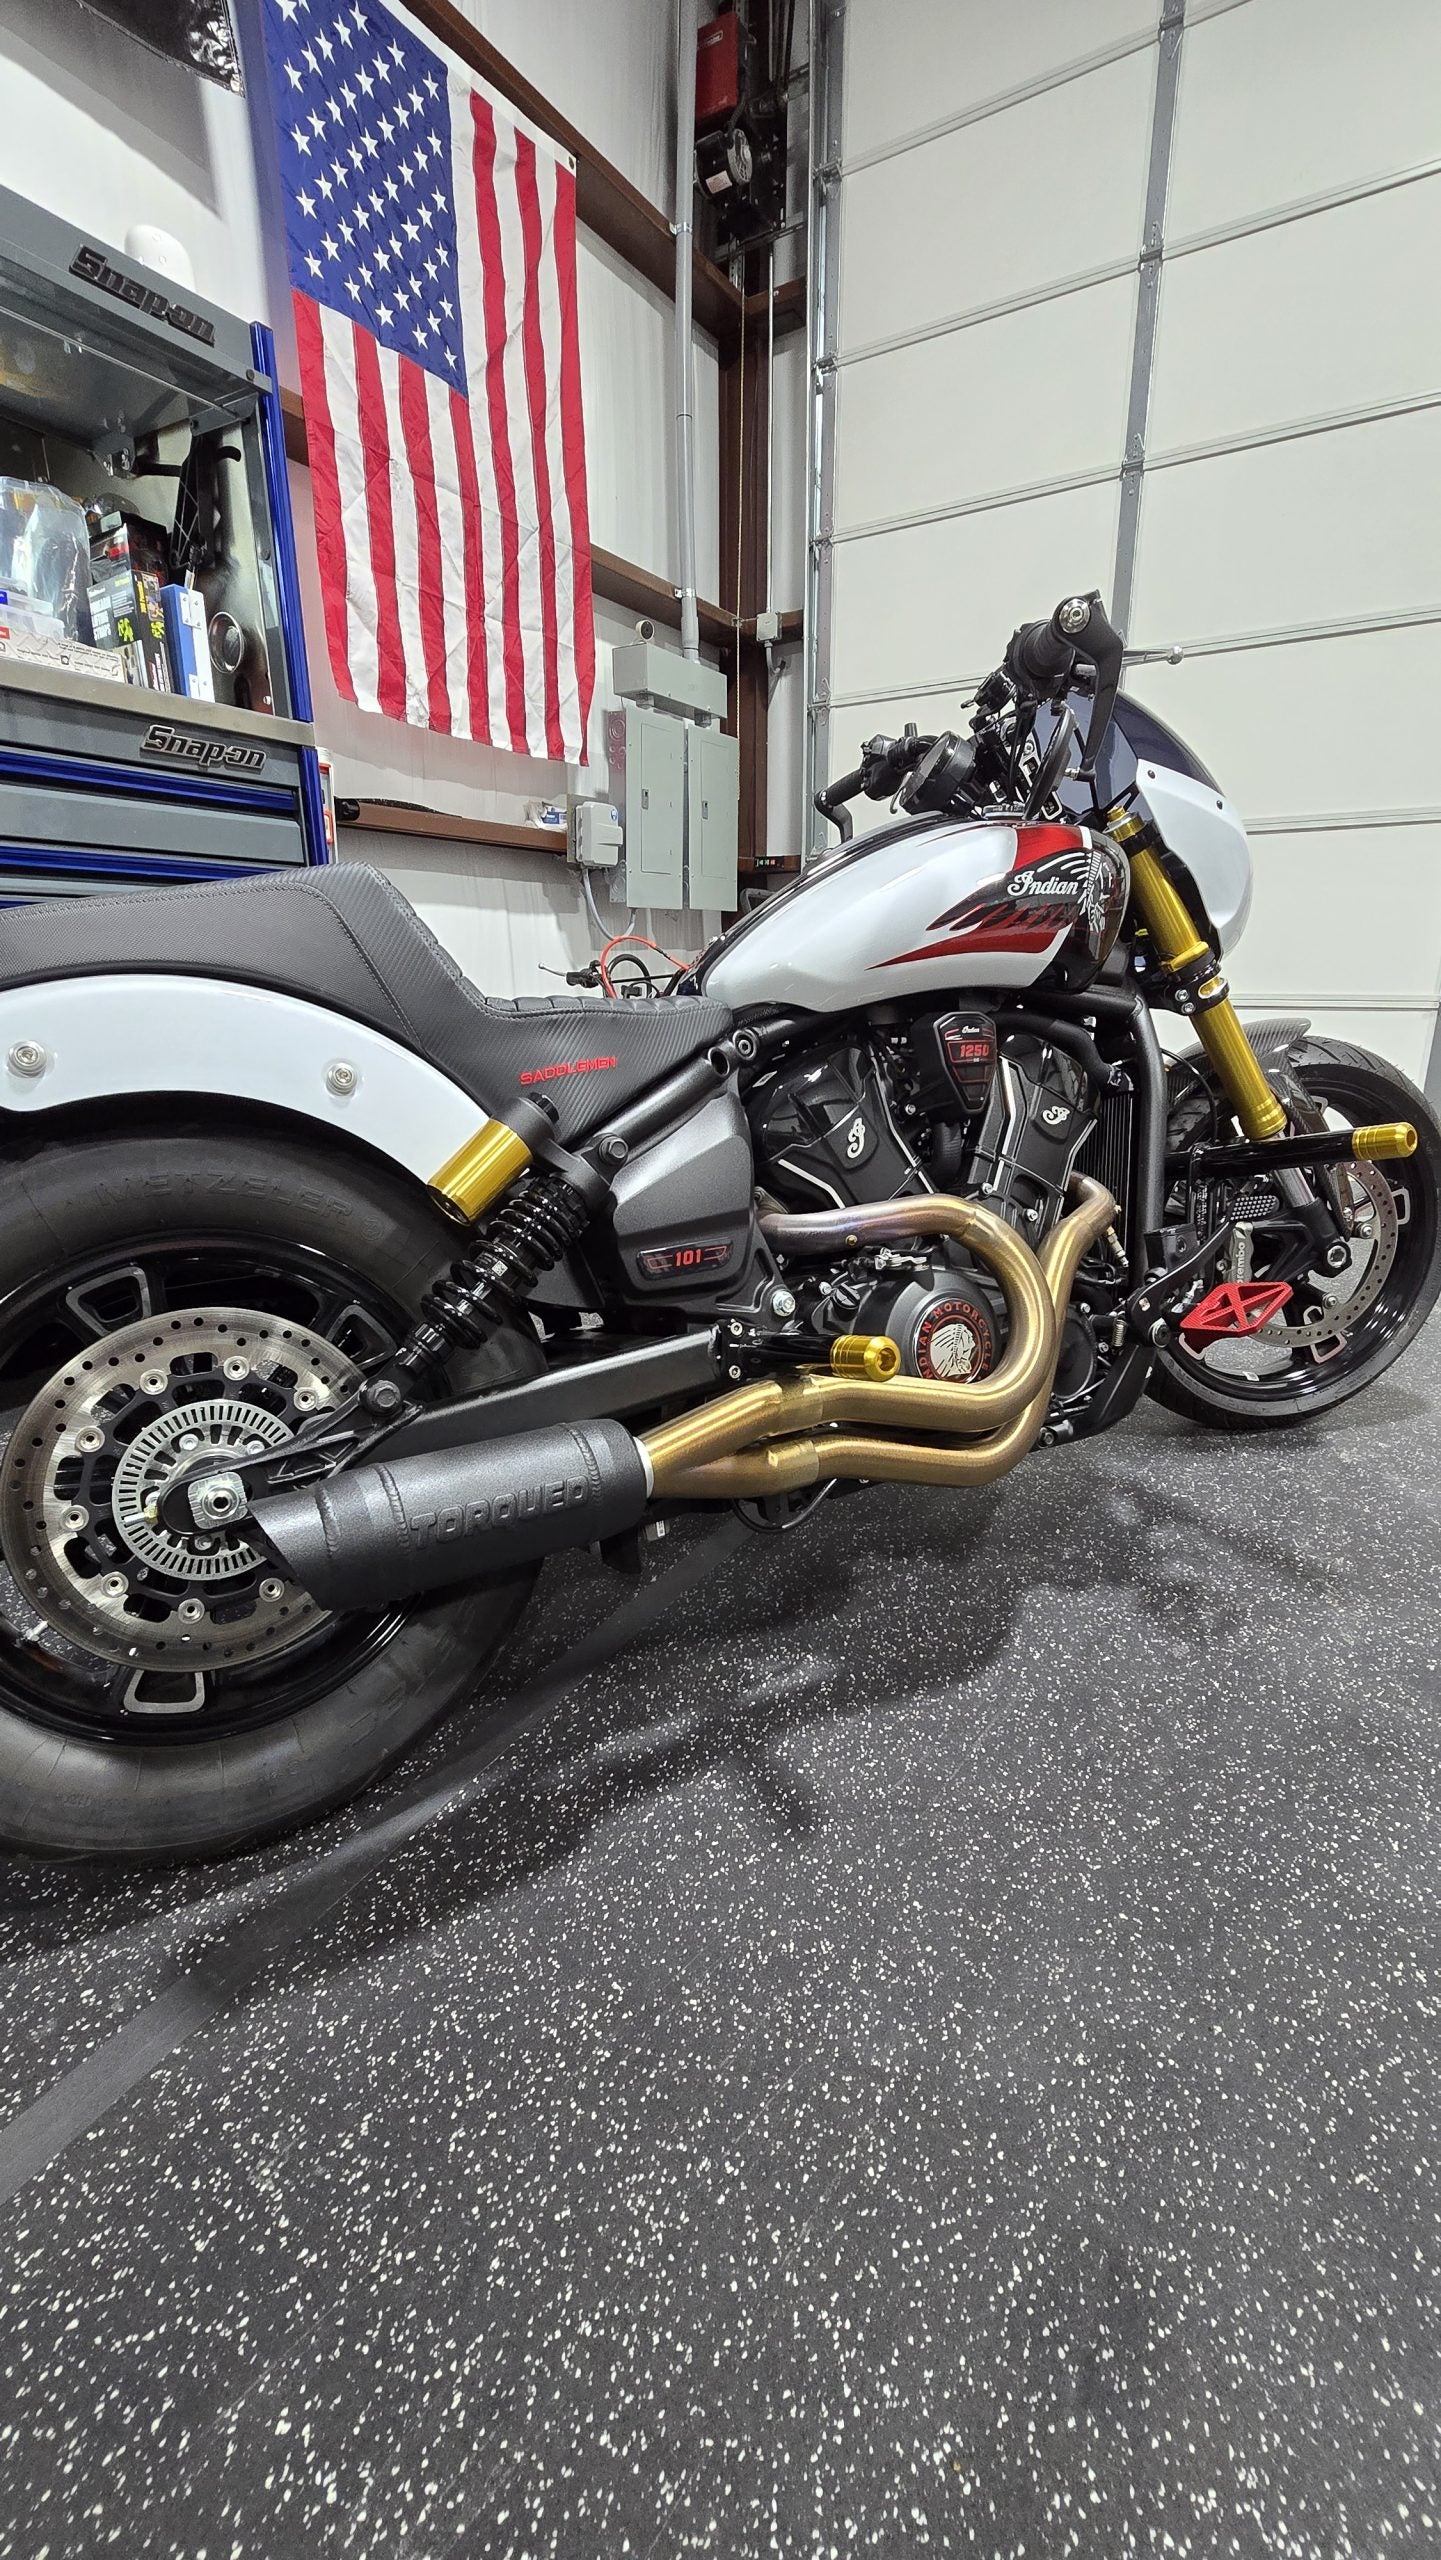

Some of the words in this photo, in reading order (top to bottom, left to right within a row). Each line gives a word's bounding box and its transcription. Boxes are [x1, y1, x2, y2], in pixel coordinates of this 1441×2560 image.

[70, 245, 215, 346] Snap-on
[141, 725, 266, 767] Snap-on
[1007, 870, 1079, 896] Indian
[520, 1057, 616, 1086] SADDLEMEN
[960, 1044, 989, 1057] 1250
[94, 1169, 353, 1226] METZELER
[676, 1248, 702, 1267] 101
[918, 1321, 933, 1379] NDIAN
[411, 1475, 590, 1547] TORQUED
